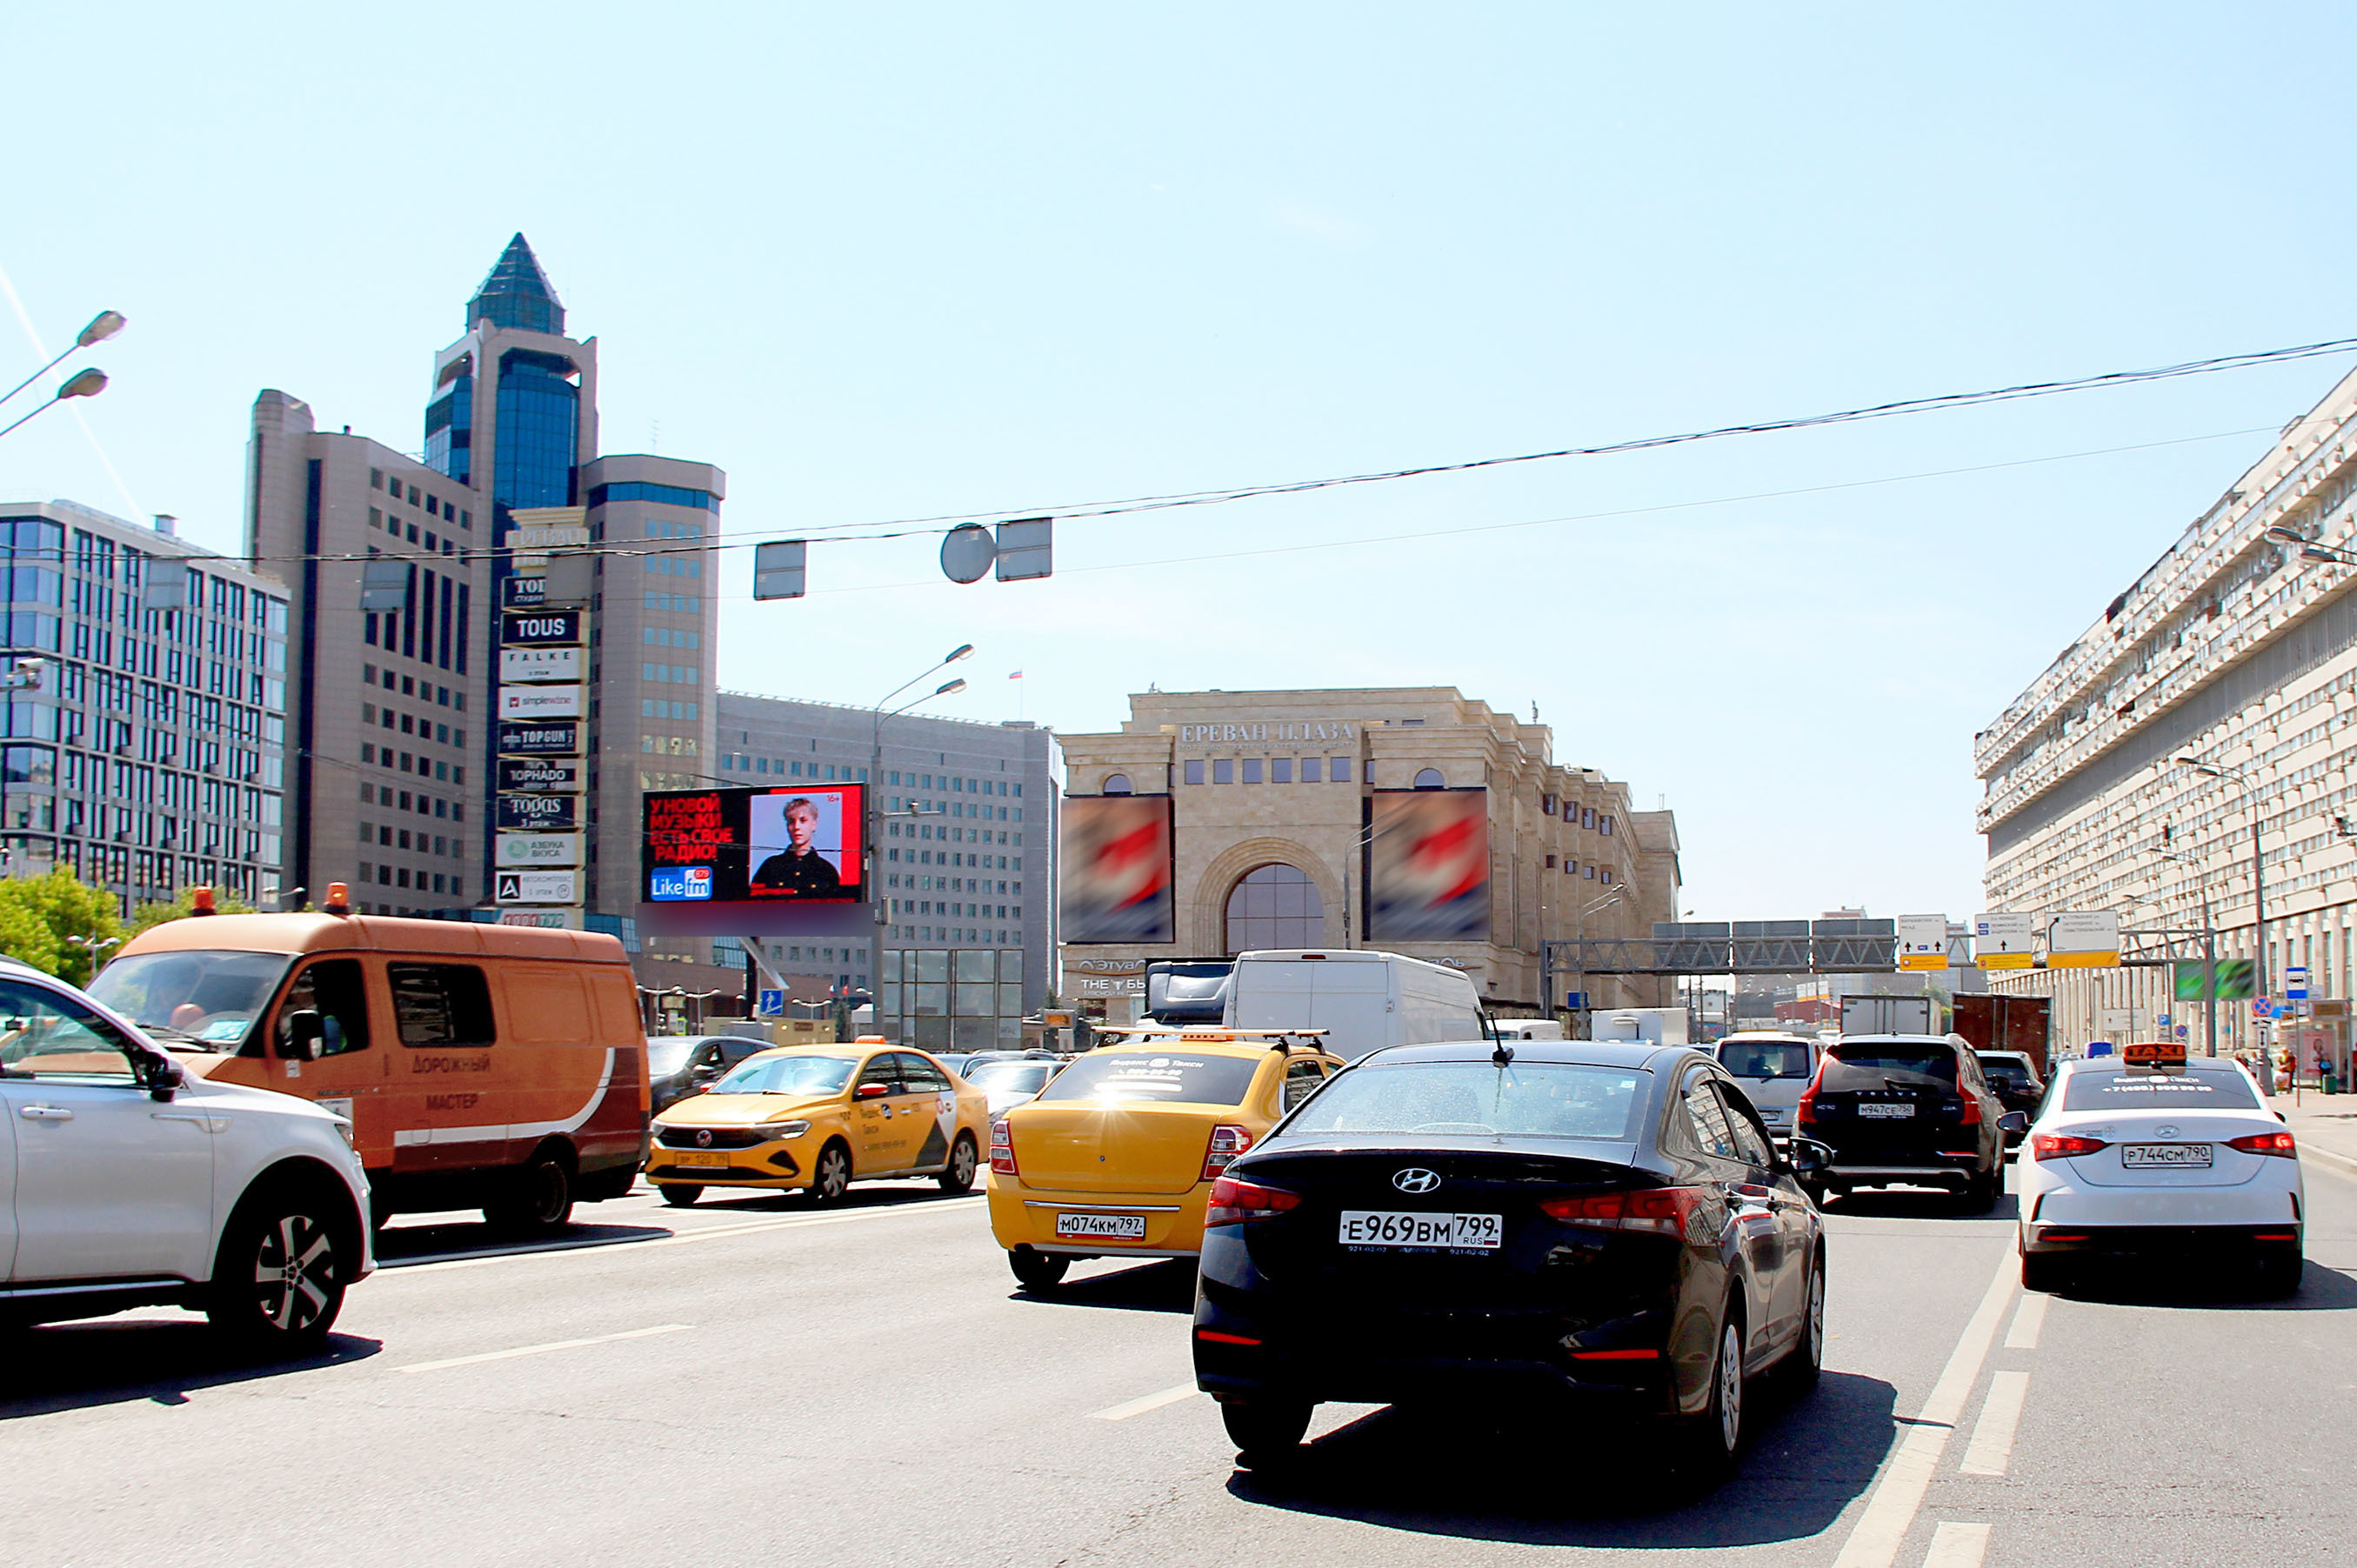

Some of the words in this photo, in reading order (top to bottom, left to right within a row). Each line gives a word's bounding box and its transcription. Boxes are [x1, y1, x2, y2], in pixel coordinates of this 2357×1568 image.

[517, 618, 565, 637] TOUS
[510, 651, 571, 662] FALKE
[1182, 724, 1267, 743] ЕРЕВАН
[1279, 722, 1353, 740] ПЛАЗА
[663, 793, 721, 813] НОВОЙ
[649, 812, 722, 830] МУЗЫКИ
[649, 830, 691, 845] ЕСТЬ
[655, 844, 718, 863] РАДИО!
[651, 873, 684, 896] Like
[1080, 979, 1110, 990] THE
[2127, 1045, 2185, 1057] TAXI
[412, 1054, 491, 1074] ДОРОЖНЫЙ
[425, 1093, 478, 1111] МАСТЕР
[2127, 1147, 2184, 1162] Р744СМ
[2185, 1146, 2208, 1158] 790
[1061, 1216, 1117, 1233] М074КМ
[1118, 1218, 1140, 1230] 797
[1348, 1214, 1452, 1243] Е969ВМ
[1455, 1216, 1495, 1237] 799
[1462, 1237, 1483, 1245] RUS
